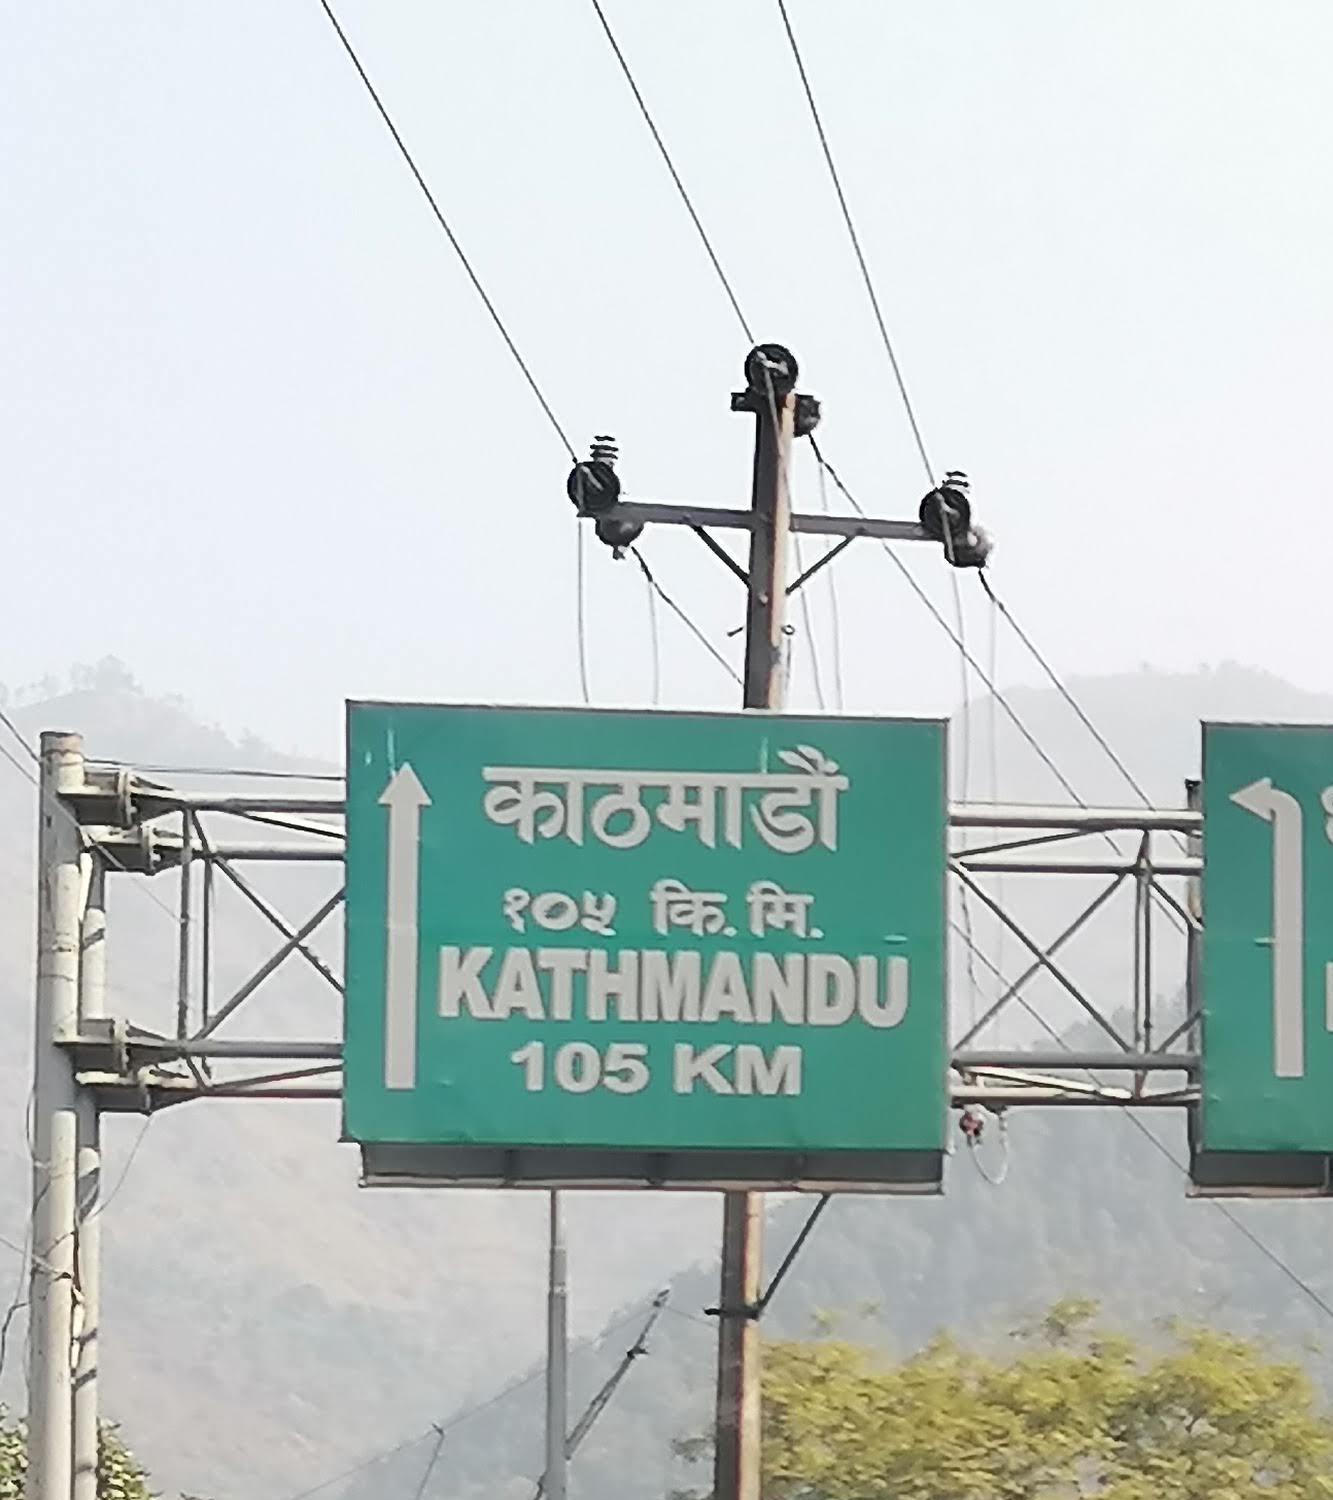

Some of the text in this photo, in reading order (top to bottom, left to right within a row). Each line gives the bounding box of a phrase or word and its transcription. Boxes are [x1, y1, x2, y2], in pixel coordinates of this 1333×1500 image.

[503, 887, 618, 936] १०५
[437, 946, 909, 1029] KATHMANDU
[511, 1041, 803, 1096] 105 KM
